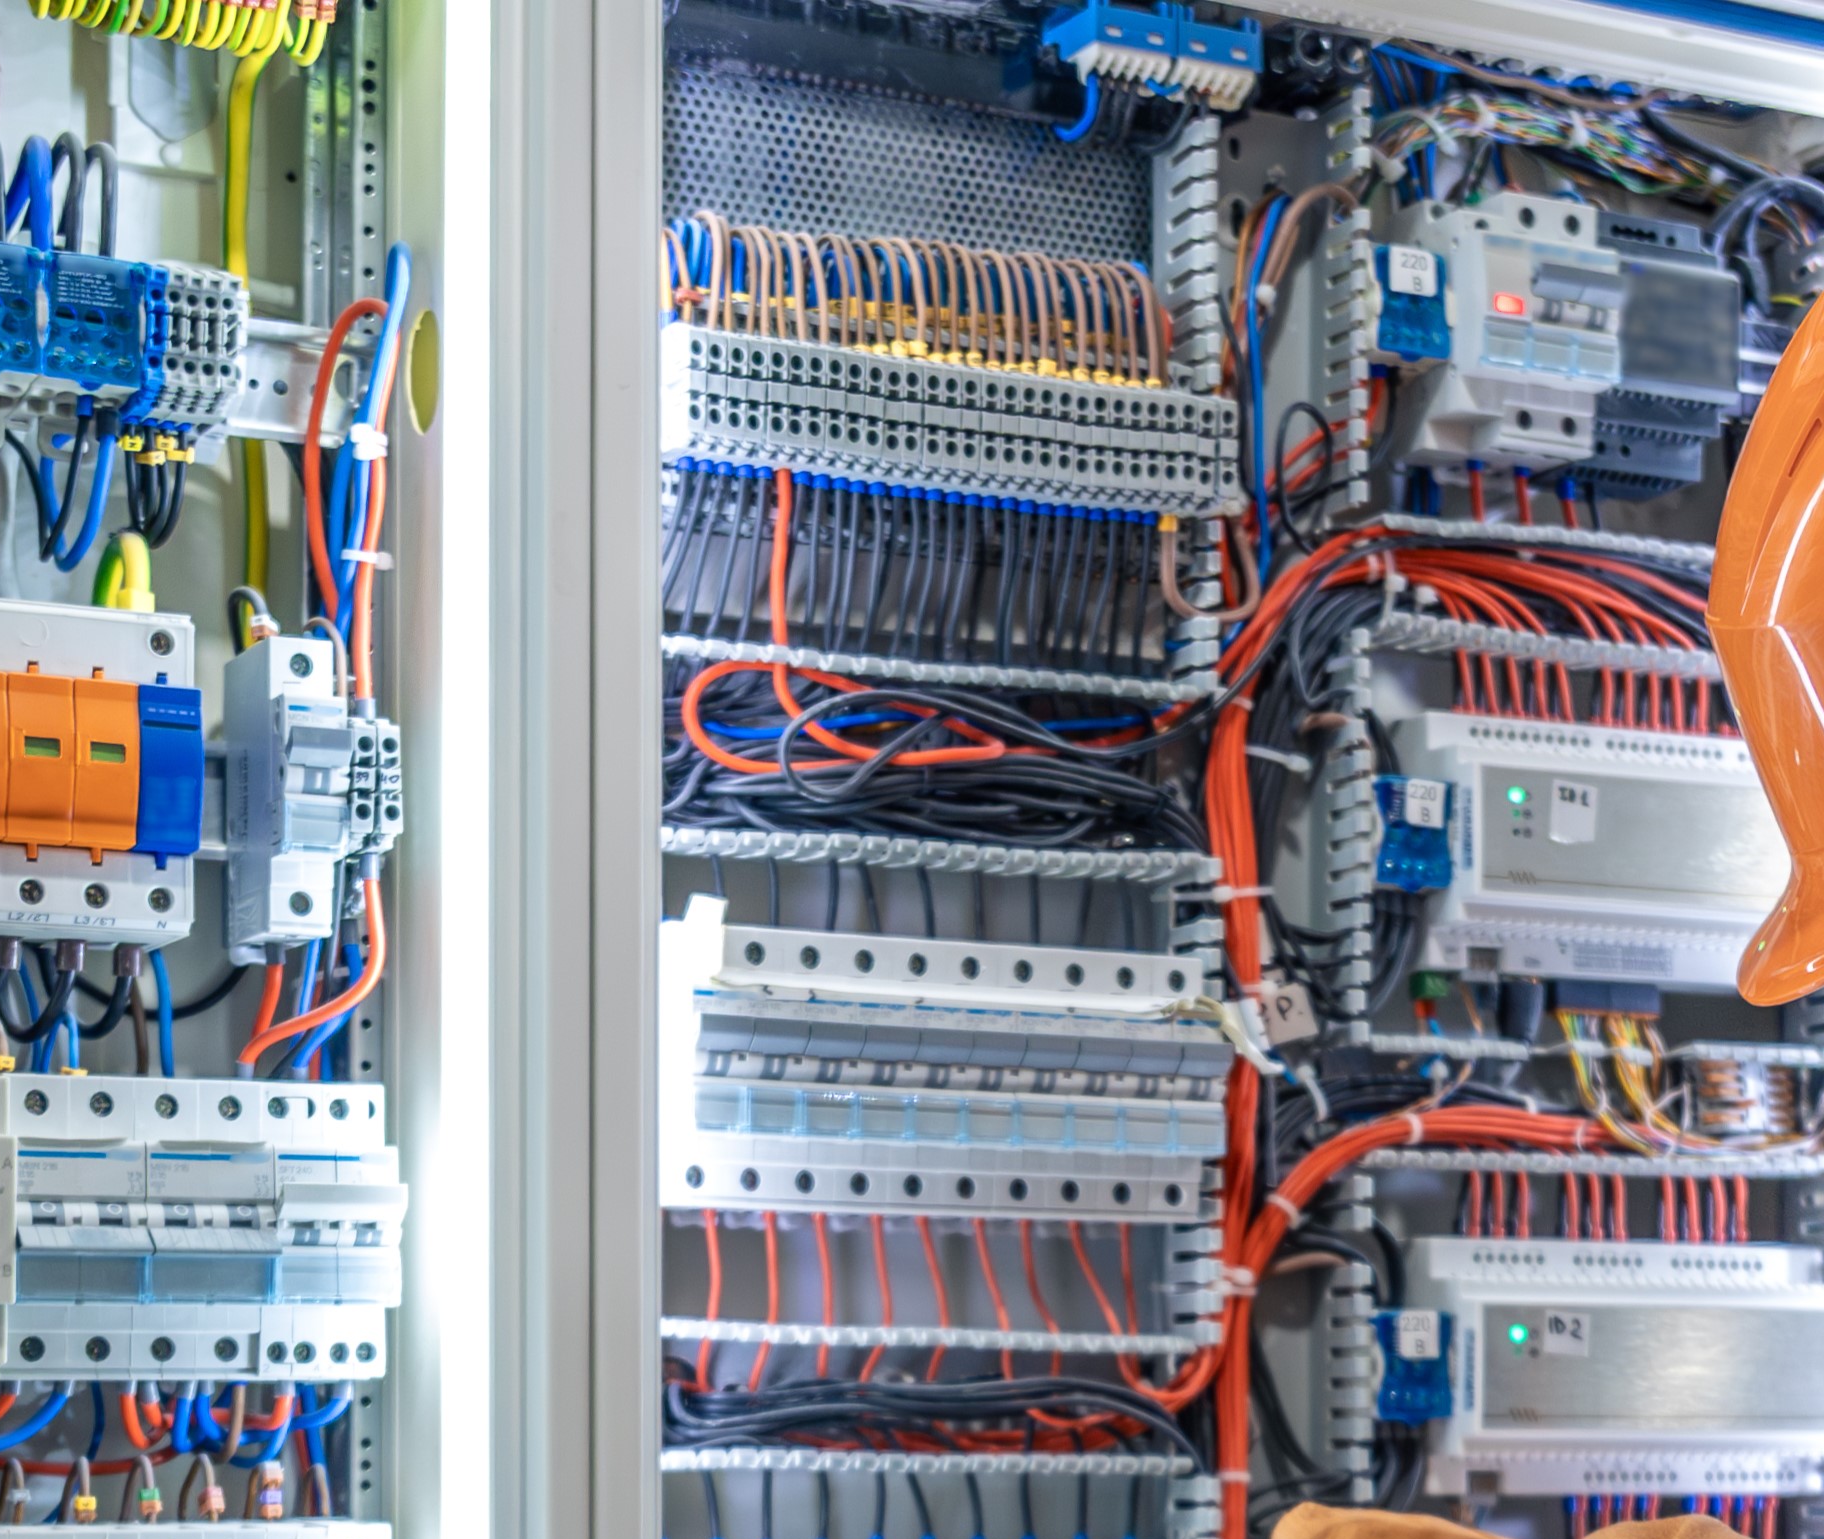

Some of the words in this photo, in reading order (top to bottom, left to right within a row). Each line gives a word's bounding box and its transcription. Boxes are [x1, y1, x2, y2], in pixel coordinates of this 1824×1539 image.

[1401, 252, 1428, 270] 220
[1, 1157, 13, 1169] A
[2, 1264, 12, 1277] B
